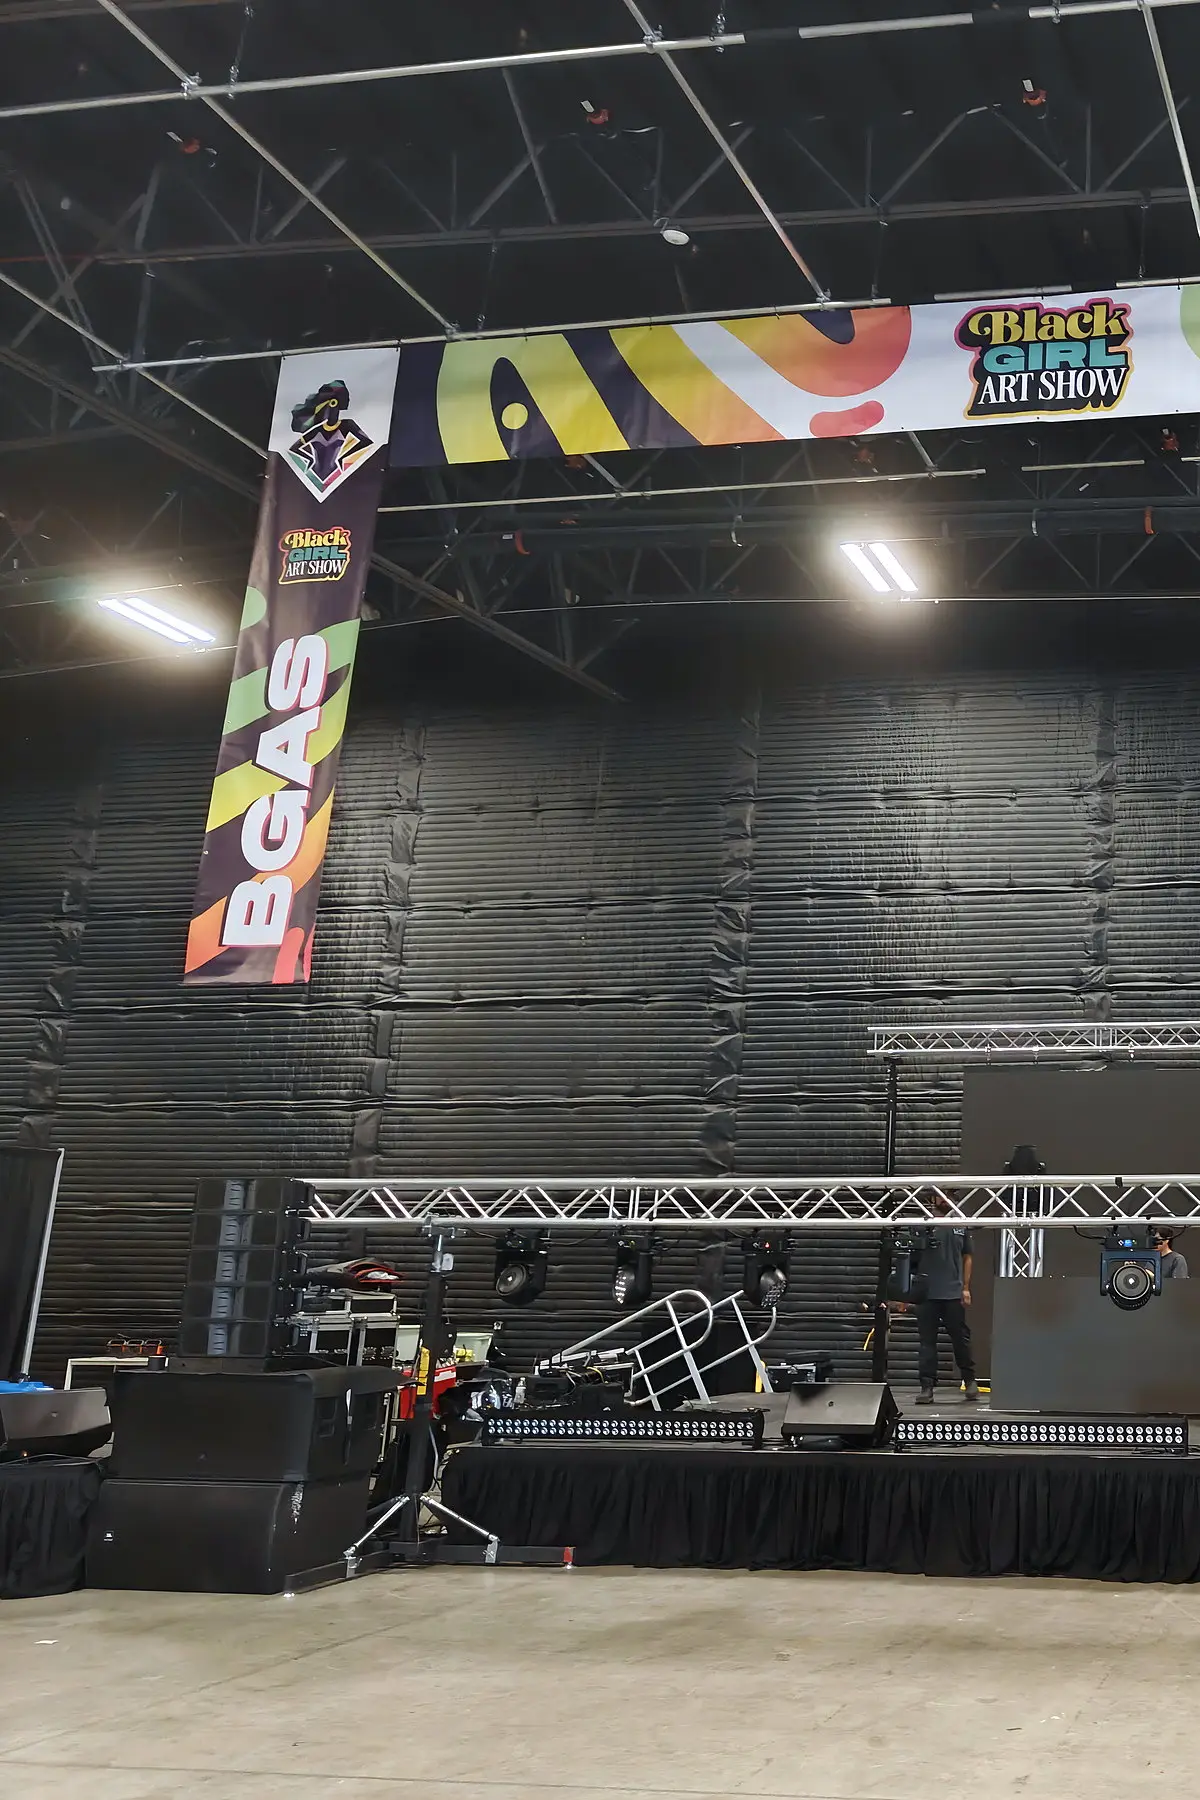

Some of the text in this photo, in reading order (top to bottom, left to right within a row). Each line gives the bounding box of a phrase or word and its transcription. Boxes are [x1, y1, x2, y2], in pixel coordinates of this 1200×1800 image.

[968, 304, 1127, 345] Black
[983, 339, 1126, 374] GIRL
[977, 367, 1128, 404] ART SHOW
[284, 529, 348, 548] Black
[288, 546, 347, 562] GIRL
[285, 560, 346, 577] ART SHOW
[221, 634, 327, 946] BGAS
